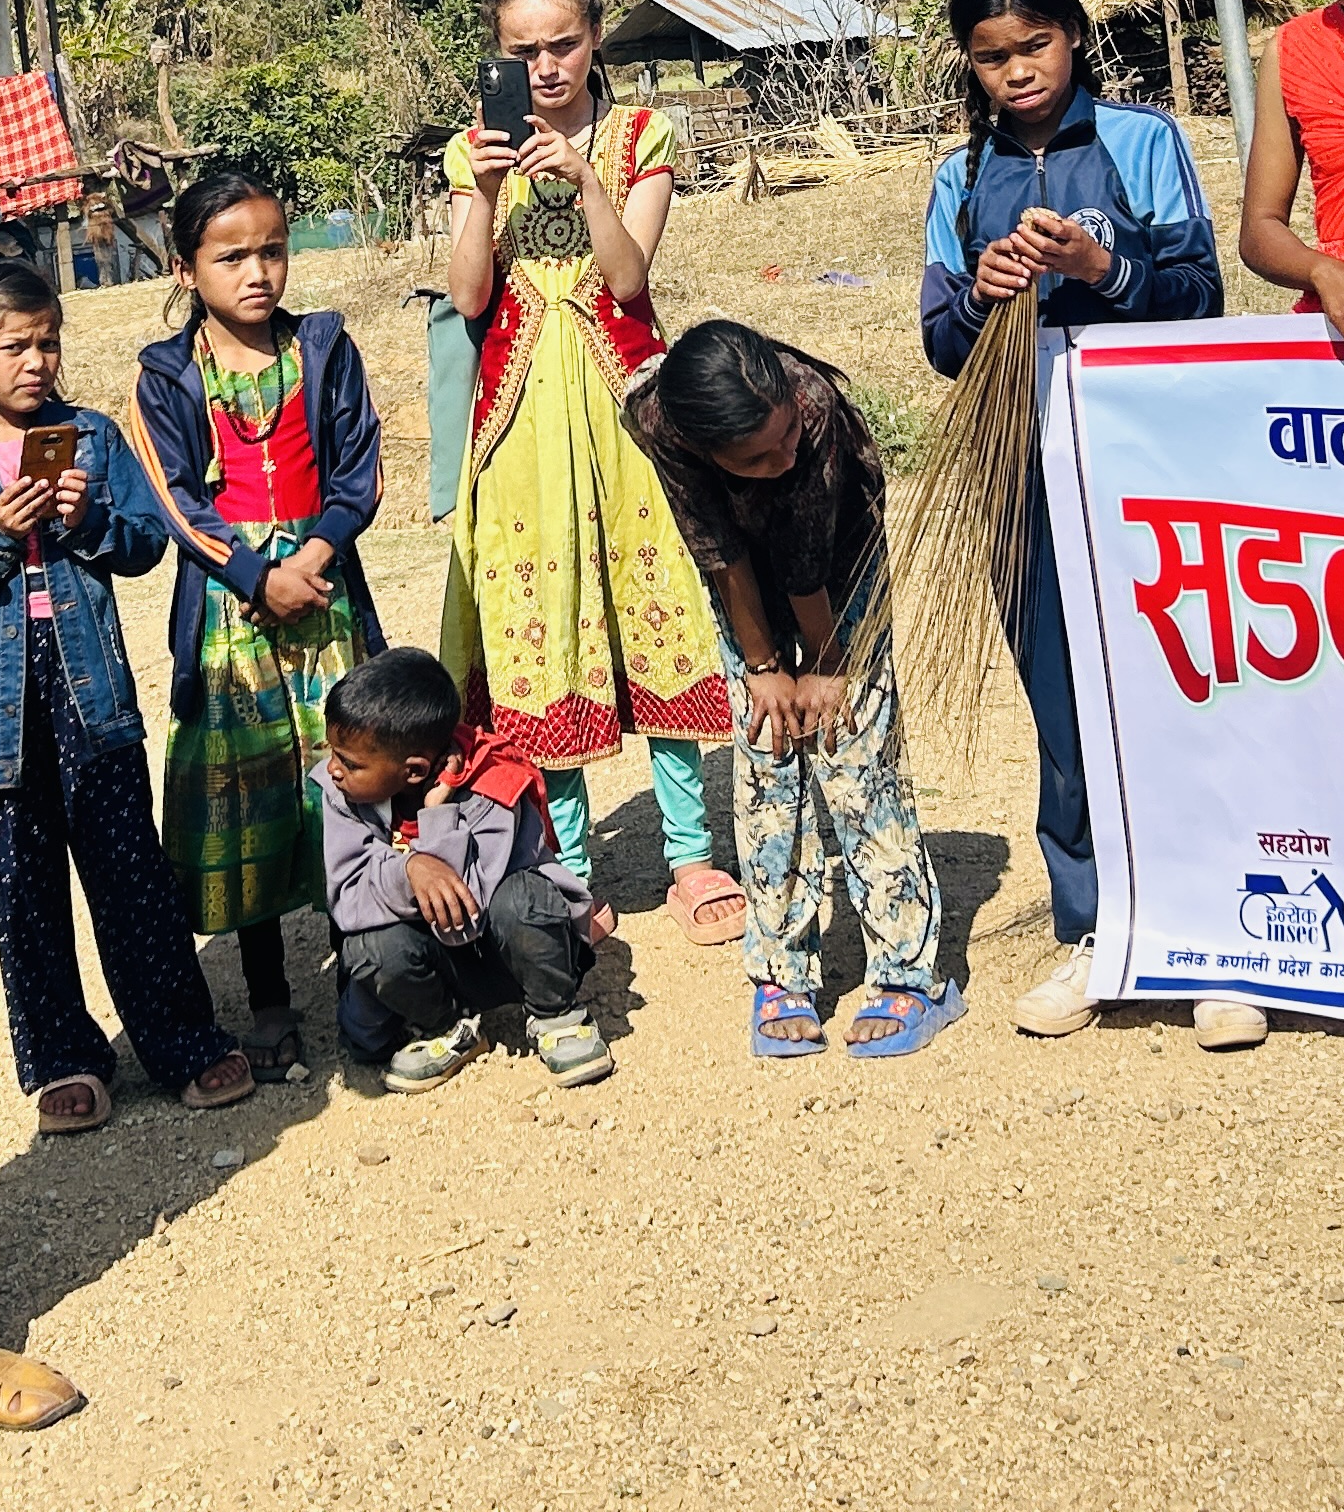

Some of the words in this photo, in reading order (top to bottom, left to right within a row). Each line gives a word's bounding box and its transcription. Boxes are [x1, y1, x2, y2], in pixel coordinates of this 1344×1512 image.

[1256, 828, 1331, 859] सहयोग
[1216, 950, 1271, 973] कर्णाली
[1278, 954, 1313, 977] प्रदेश
